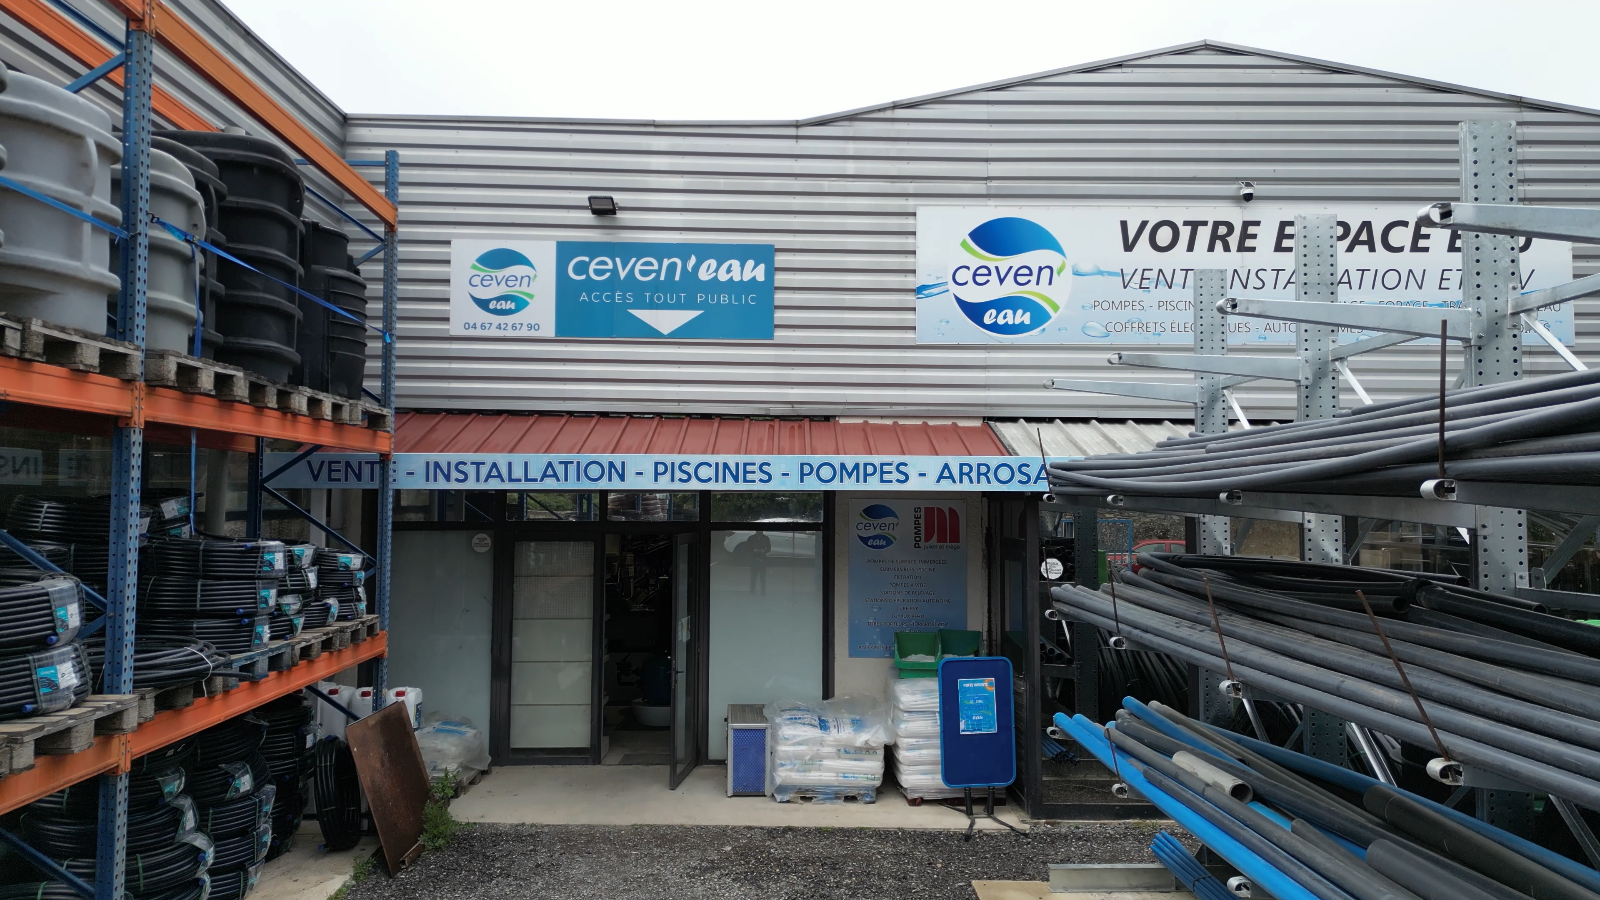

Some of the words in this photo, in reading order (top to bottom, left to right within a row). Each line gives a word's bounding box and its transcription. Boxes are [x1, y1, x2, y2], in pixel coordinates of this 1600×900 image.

[1119, 219, 1262, 253] VOTRE
[1273, 219, 1431, 253] EPACE
[1120, 269, 1194, 290] VENT
[1230, 268, 1426, 290] NSTAATION
[488, 300, 516, 311] eau
[579, 290, 634, 303] ACCÈS
[644, 292, 687, 304] TOUT
[697, 293, 757, 305] PUBLIC
[1093, 299, 1145, 311] POMPES
[1157, 300, 1194, 311] PISCIN
[982, 307, 1031, 326] eau
[463, 321, 477, 331] 04
[480, 322, 493, 331] 67
[495, 322, 509, 331] 42
[511, 322, 524, 331] 67
[526, 322, 540, 332] 90
[1105, 321, 1167, 333] COFFRETS
[306, 460, 397, 482] VENT
[425, 460, 627, 483] INSTALLATION
[653, 461, 773, 484] PISCINES
[800, 461, 910, 485] POMPES
[935, 462, 1049, 485] ARROSA
[914, 506, 922, 549] POMPES
